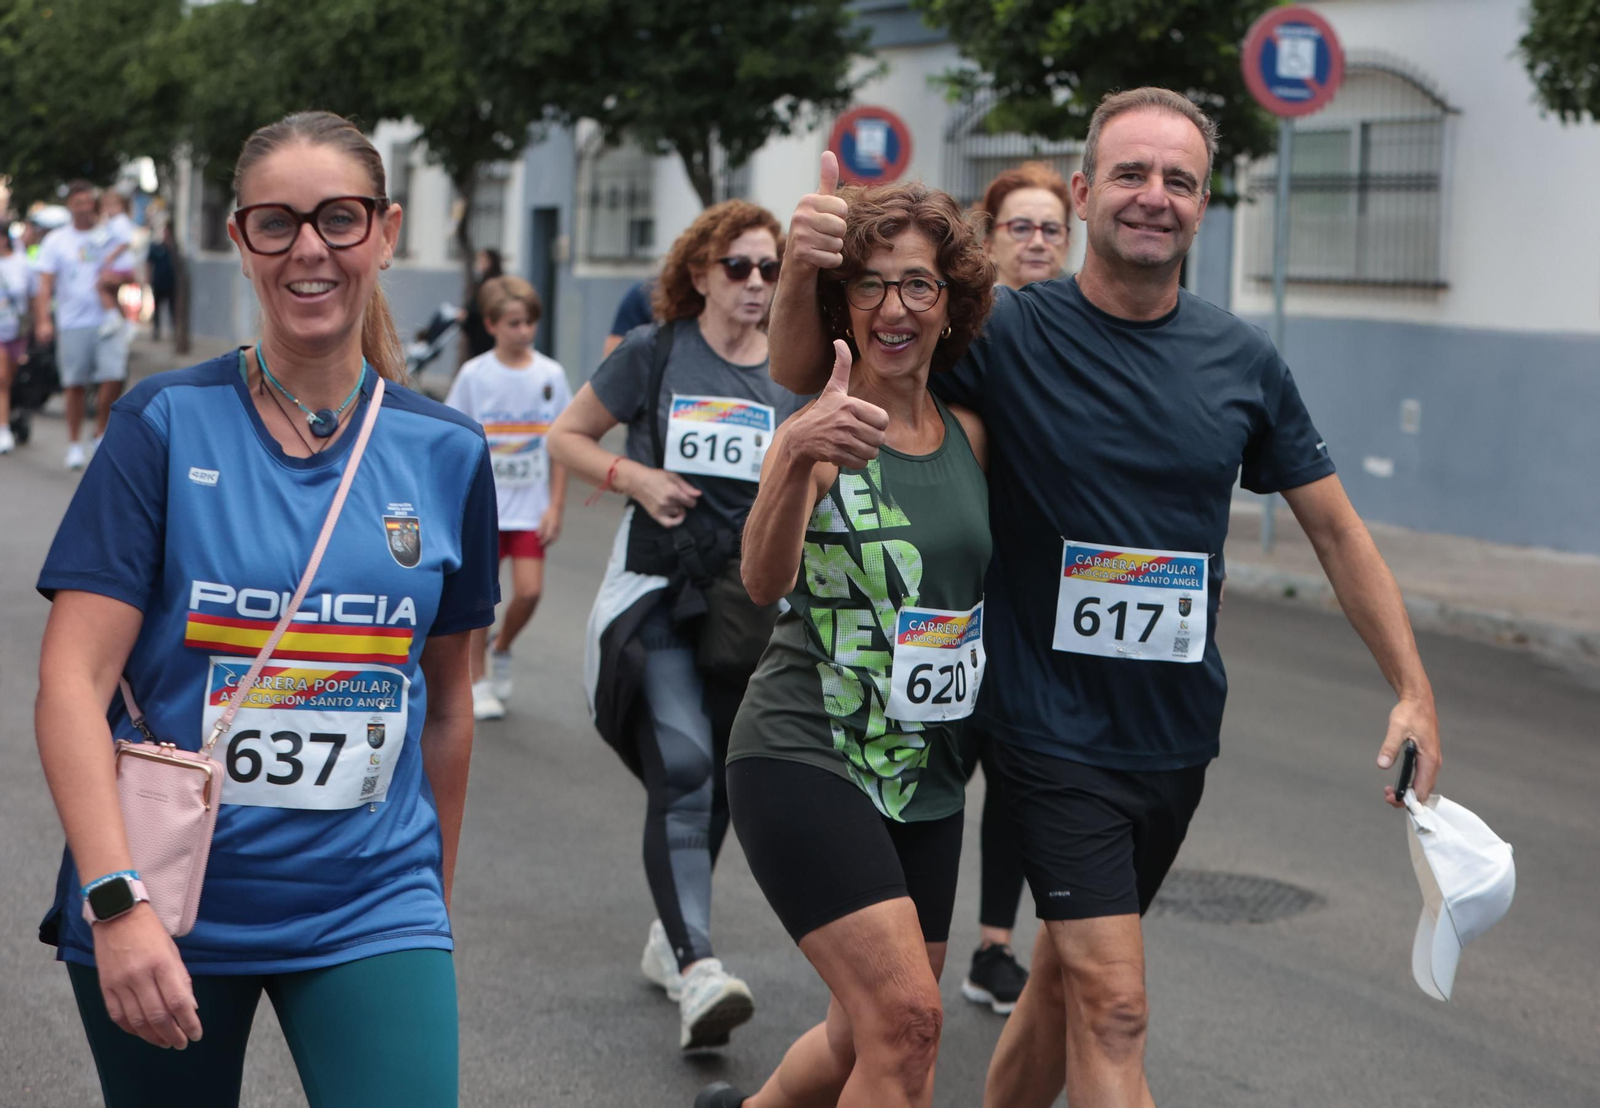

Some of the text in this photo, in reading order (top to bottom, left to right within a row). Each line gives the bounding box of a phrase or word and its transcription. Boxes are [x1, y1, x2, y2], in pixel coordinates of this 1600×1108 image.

[679, 431, 743, 464] 616
[1075, 554, 1196, 576] CARRERA POPULAR
[1071, 567, 1200, 587] ASOCIACION SANTO ANGEL
[908, 619, 964, 634] CARRERA
[1073, 596, 1164, 643] 617
[314, 679, 391, 694] POPULAR
[906, 660, 967, 705] 620
[309, 696, 354, 707] SANTO
[356, 697, 397, 710] ANGEL
[225, 729, 347, 786] 637
